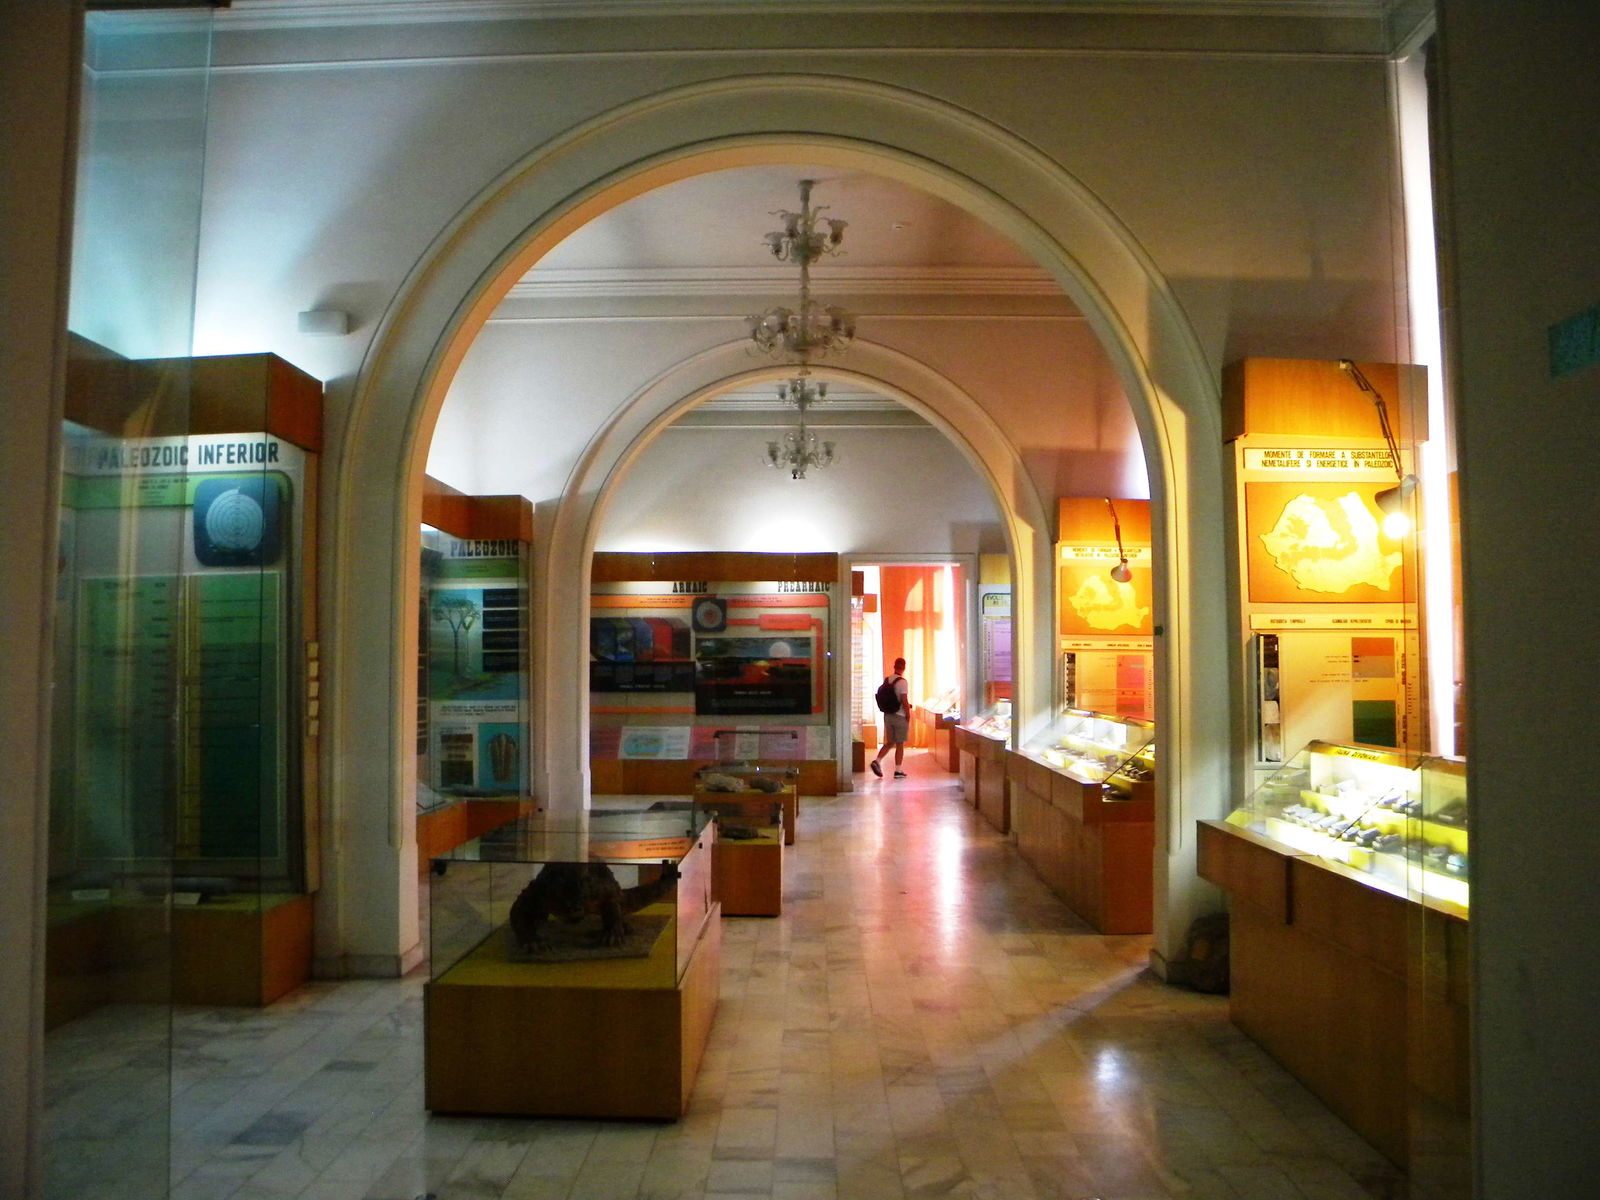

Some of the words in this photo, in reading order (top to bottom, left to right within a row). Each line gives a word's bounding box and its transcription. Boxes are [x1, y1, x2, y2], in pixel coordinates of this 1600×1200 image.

[98, 445, 189, 469] PALEOZOIC
[198, 442, 279, 465] INFERIOR
[1264, 451, 1292, 459] MOMENTE
[1309, 451, 1336, 459] FORMARE
[450, 540, 519, 557] PALEOZOIC
[672, 581, 708, 593] ARHAIC
[777, 581, 831, 593] PREARHAIC
